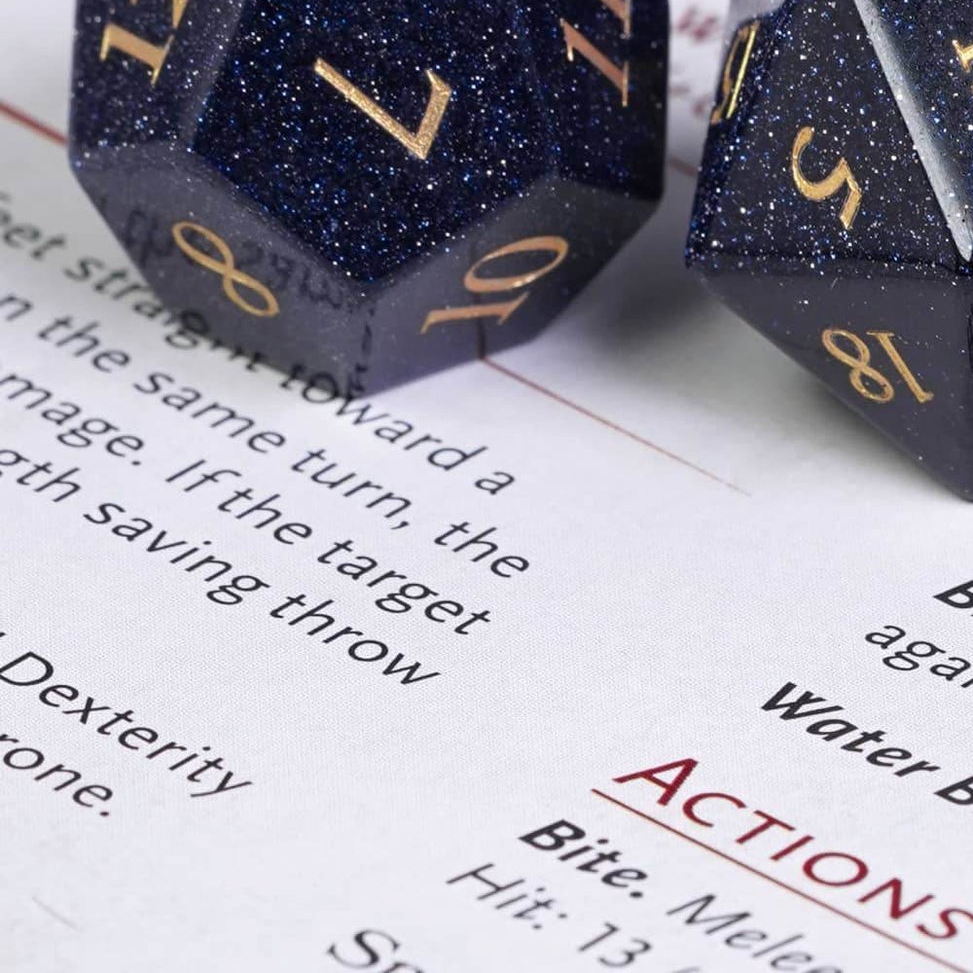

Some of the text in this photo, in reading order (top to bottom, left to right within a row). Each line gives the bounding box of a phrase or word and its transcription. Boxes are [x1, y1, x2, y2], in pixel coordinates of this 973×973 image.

[314, 57, 452, 160] 7
[791, 126, 862, 230] 5
[172, 221, 279, 317] 8
[421, 235, 569, 333] 10
[822, 327, 933, 405] 18
[38, 316, 130, 373] the
[133, 371, 286, 453] same
[291, 448, 412, 530] turn,
[433, 521, 530, 579] the
[474, 470, 516, 496] a
[0, 374, 493, 637] mage. If the target
[83, 502, 271, 606] saving
[269, 593, 441, 689] throw
[0, 651, 253, 798] Dexterity
[760, 682, 942, 778] Water
[517, 819, 648, 899] Bite.
[446, 863, 653, 969] Hit: 13
